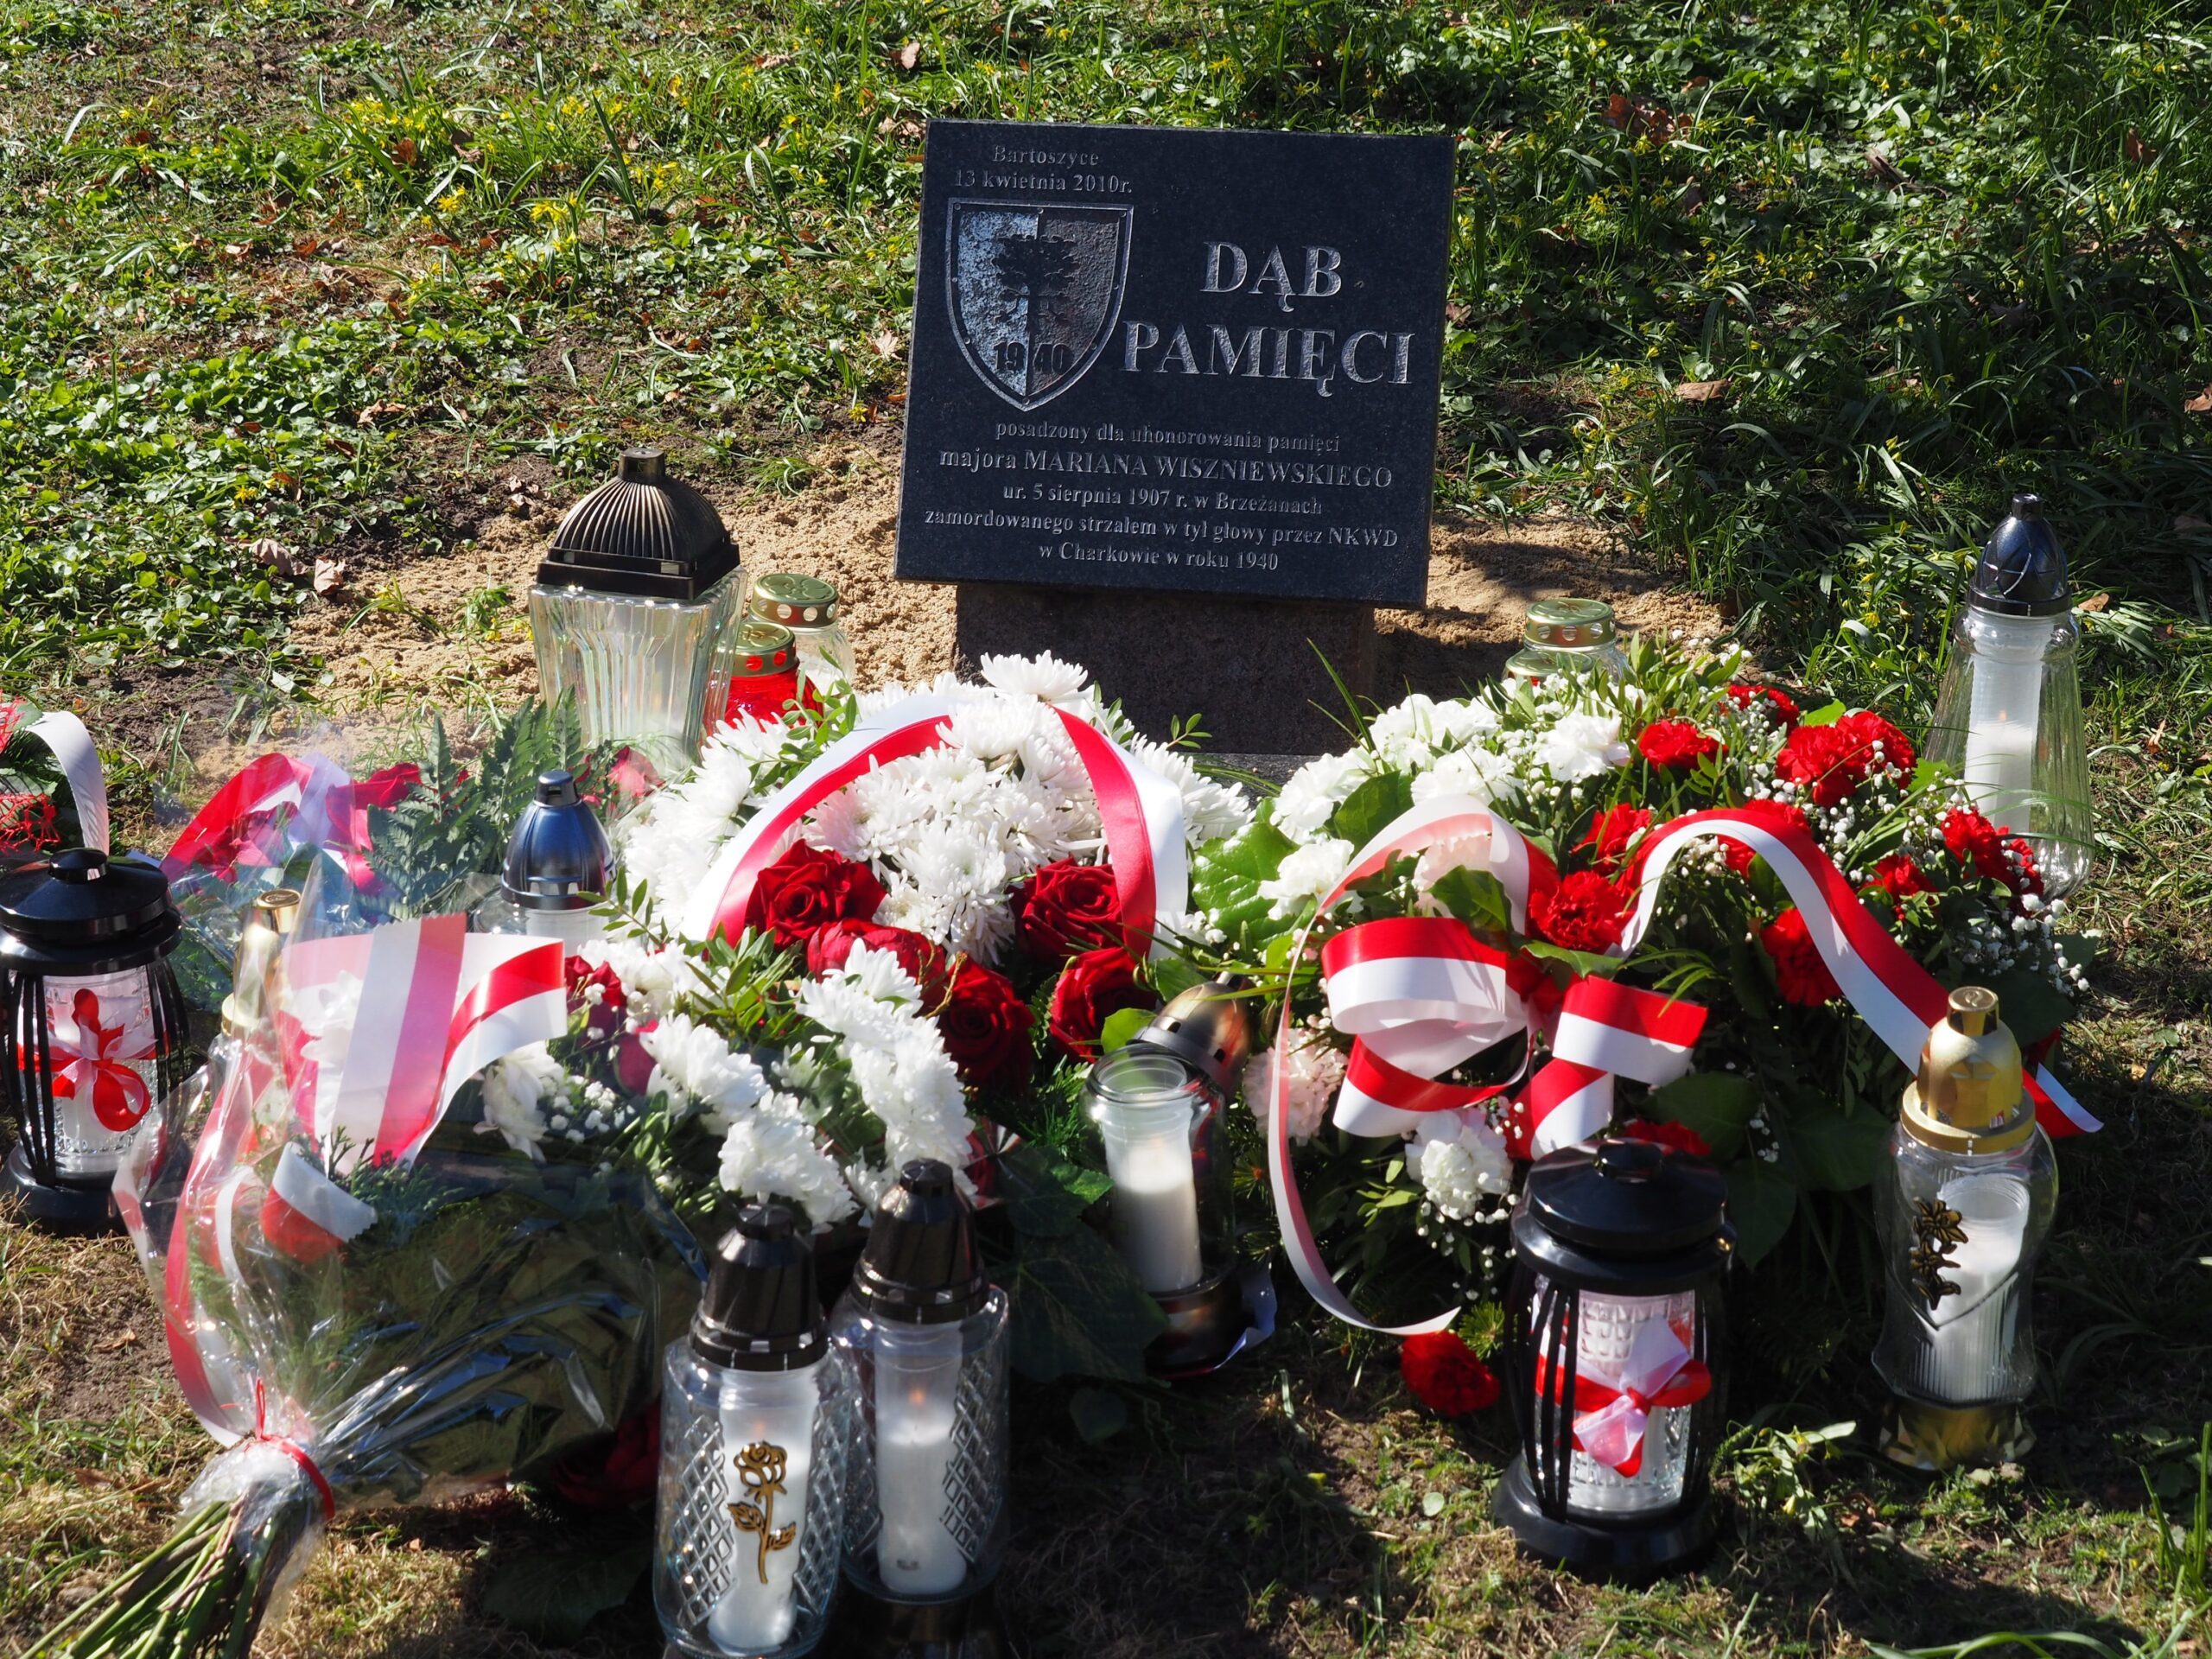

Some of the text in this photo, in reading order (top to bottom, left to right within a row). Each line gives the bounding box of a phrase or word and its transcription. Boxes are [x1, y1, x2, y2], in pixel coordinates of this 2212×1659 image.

[993, 144, 1099, 169] Bartoszyce
[954, 169, 1133, 194] 13 kwietnia 2010r.
[1200, 241, 1342, 313] DĄB
[1120, 321, 1416, 397] PAMIĘCI
[995, 421, 1339, 456] posadzony dla uhonorowania pamięci
[939, 447, 1393, 488] majora MARIANA WISZNIEWSKIEGO
[1002, 483, 1323, 515] ur. 5 sierpnia 1907 r. w Brzeżanach
[924, 509, 1073, 534] zamordowanego
[1163, 520, 1179, 536] w
[1271, 525, 1323, 546] przez
[1328, 527, 1398, 547] NKWD
[1038, 542, 1279, 570] w Charkowie w roku 1940
